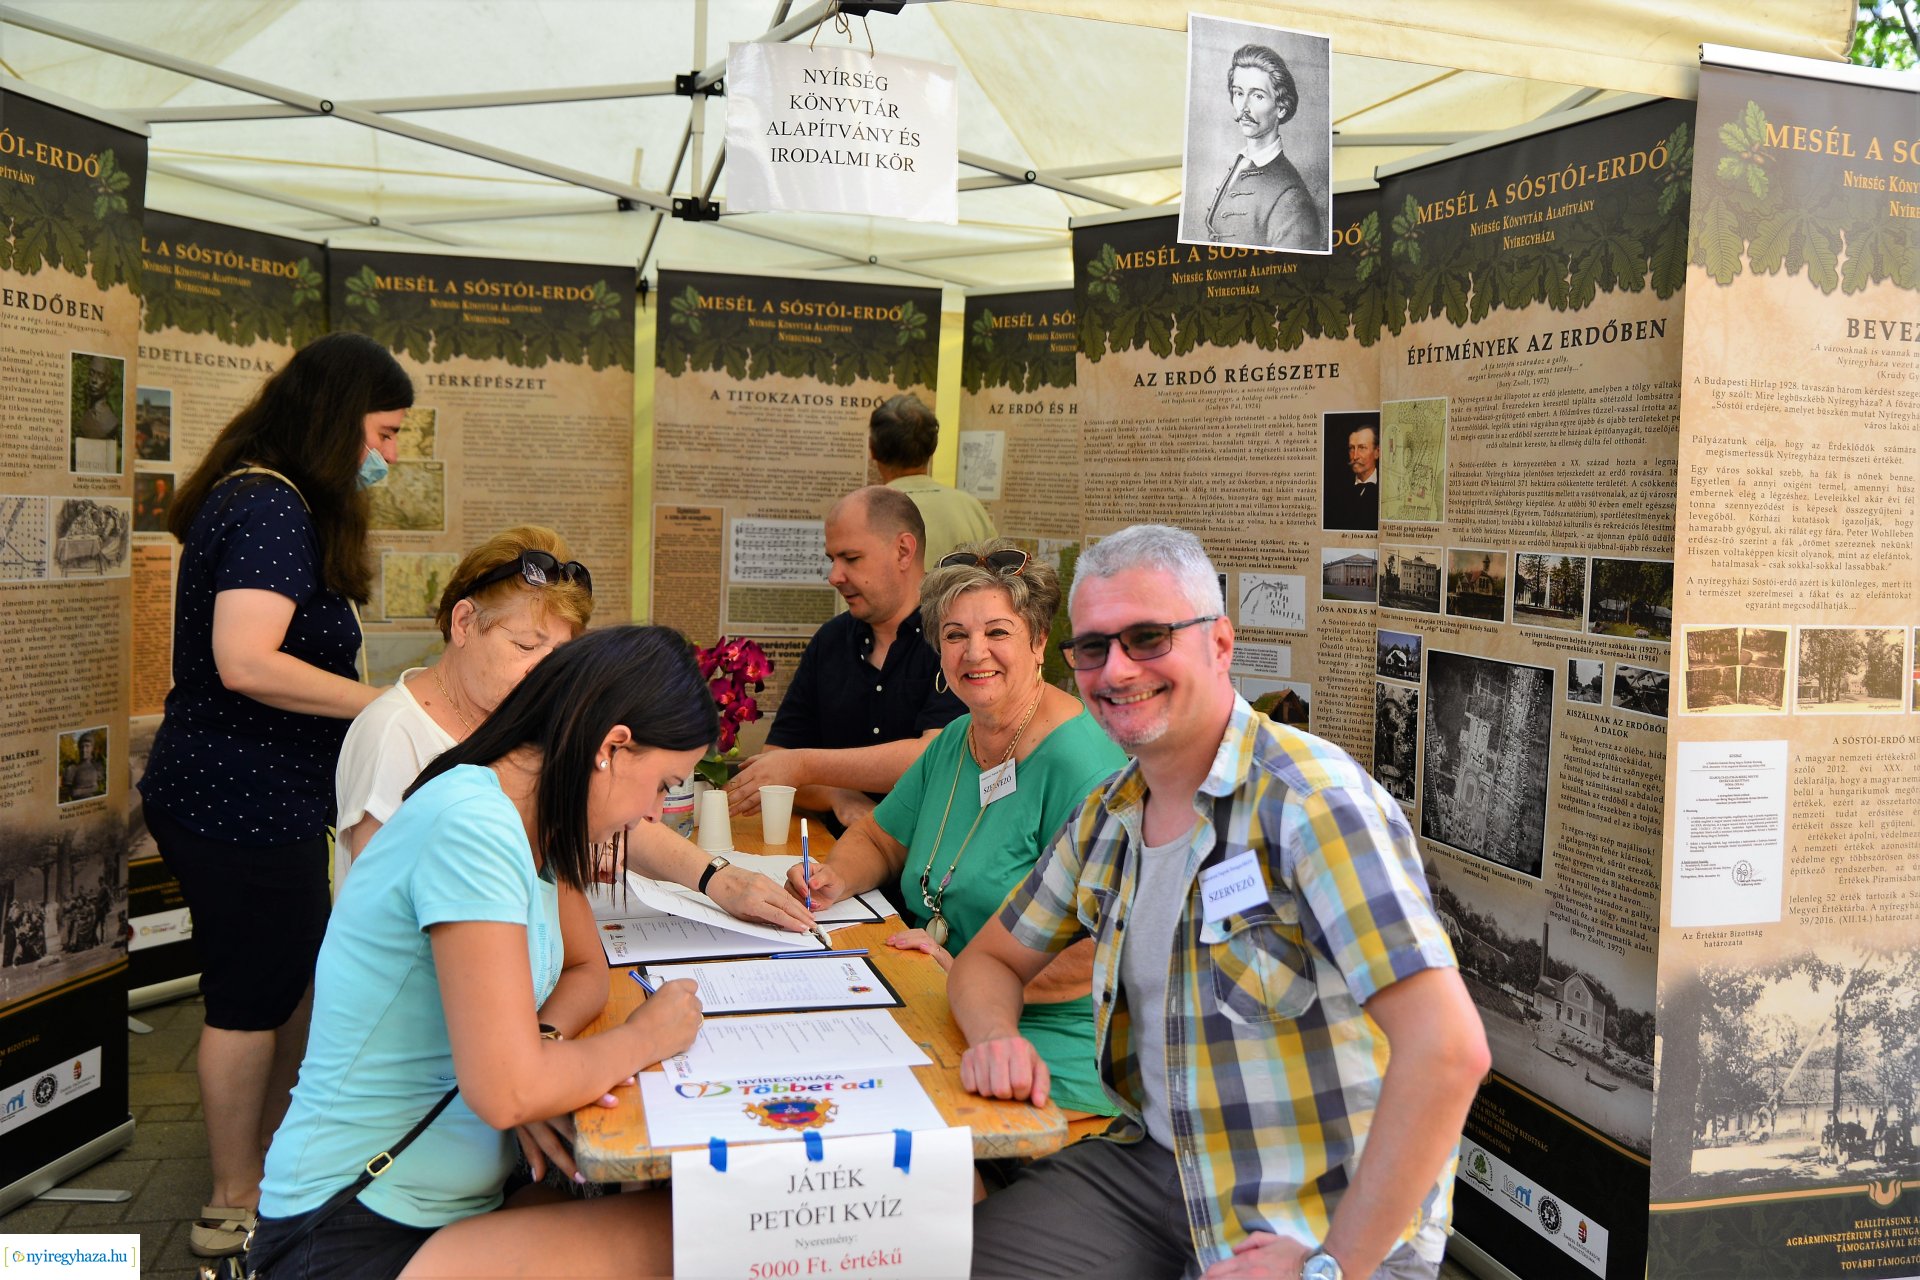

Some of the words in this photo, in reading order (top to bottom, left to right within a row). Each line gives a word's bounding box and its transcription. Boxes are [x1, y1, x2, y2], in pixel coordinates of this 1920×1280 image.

[803, 67, 888, 91] NYÍRSÉG
[790, 93, 900, 119] KÖNYVTÁR
[766, 119, 894, 144] ALAPÍTVÁNY
[899, 127, 920, 147] ÉS
[1764, 123, 1855, 157] MESÉL
[1865, 138, 1884, 161] A
[770, 147, 869, 167] IRODALMI
[876, 153, 915, 172] KÖR
[1417, 191, 1478, 225] MESÉL
[1485, 188, 1498, 209] A
[1505, 140, 1669, 204] SÓSTÓI-ERDŐ
[1844, 171, 1885, 191] NYÍRSÉG
[1470, 219, 1500, 237] NYÍRSÉG
[1503, 210, 1543, 230] KÖNYVTÁR
[1546, 200, 1595, 220] ALAPÍTVÁNY
[1503, 231, 1555, 251] NYÍREGYHÁZA
[157, 241, 170, 256] A
[176, 243, 299, 279] SÓSTÓI-ERDŐ
[1116, 245, 1181, 270] MESÉL
[1187, 246, 1200, 263] A
[374, 275, 438, 293] MESÉL
[445, 281, 458, 294] A
[464, 279, 595, 301] SÓSTÓI-ERDŐ
[2, 288, 104, 322] ERDŐBEN
[698, 296, 756, 312] MESÉL
[763, 301, 775, 313] A
[780, 299, 901, 321] SÓSTÓI-ERDŐ
[992, 312, 1034, 328] MESÉL
[1039, 313, 1048, 326] A
[1407, 336, 1519, 365] ÉPÍTMÉNYEK
[1527, 332, 1553, 352] AZ
[1560, 318, 1667, 347] ERDŐBEN
[426, 374, 547, 390] TÉRKÉPÉSZET
[1134, 373, 1157, 387] AZ
[1166, 366, 1216, 385] ERDŐ
[1225, 363, 1340, 383] RÉGÉSZETE
[1705, 377, 1747, 387] Budapesti
[1750, 379, 1776, 390] Hírlap
[1780, 381, 1799, 390] 1928.
[1801, 384, 1834, 392] tavaszán
[1837, 385, 1862, 394] három
[1865, 387, 1895, 396] kérdést
[710, 390, 720, 400] A
[727, 390, 833, 406] TITOKZATOS
[840, 395, 884, 409] ERDŐ
[989, 404, 1004, 414] AZ
[1009, 400, 1043, 414] ERDŐ
[1050, 401, 1064, 414] ÉS
[1692, 435, 1747, 446] Pályázatunk
[1756, 439, 1776, 448] célja,
[1786, 440, 1804, 450] hogy
[1829, 442, 1875, 452] Érdeklődők
[1706, 448, 1774, 458] megismertessük
[1777, 450, 1826, 462] Nyíregyháza
[1829, 454, 1872, 463] természeti
[1873, 456, 1904, 464] értékét.
[1691, 465, 1708, 475] Egy
[1780, 469, 1803, 477] szebb,
[1890, 473, 1915, 481] benne.
[1697, 578, 1750, 587] nyíregyházi
[1752, 578, 1797, 586] Sóstói-erdő
[1831, 579, 1878, 589] különleges,
[1317, 605, 1334, 613] JÓSA
[1337, 607, 1363, 615] ANDRÁS
[1567, 708, 1610, 724] KISZÁLLNAK
[1613, 718, 1623, 726] AZ
[1626, 720, 1667, 734] ERDŐBŐL
[1602, 726, 1628, 738] DALOK
[1842, 735, 1905, 744] SÓSTÓI-ERDŐ
[1209, 874, 1255, 902] SZERVEZŐ
[1682, 932, 1693, 940] Az
[1696, 928, 1727, 940] Értéktár
[1730, 929, 1763, 940] Bizottság
[1704, 939, 1743, 948] határozata
[736, 1074, 845, 1085] NYÍREGYHÁZA
[739, 1082, 834, 1095] Többet
[841, 1079, 884, 1090] ad!
[787, 1165, 864, 1194] JÁTÉK
[750, 1202, 835, 1231] PETŐFI
[844, 1195, 903, 1221] KVÍZ
[1855, 1216, 1911, 1229] KIÁLLÍTÁSUNK
[795, 1234, 858, 1248] Nyeremény:
[1787, 1230, 1871, 1247] AGRÁRMINISZTÉRIUM
[1874, 1230, 1882, 1239] ÉS
[1885, 1230, 1889, 1238] A
[1837, 1238, 1905, 1253] TÁMOGATÁSÁVAL
[750, 1260, 799, 1279] 5000
[807, 1257, 832, 1274] Ft.
[841, 1249, 903, 1270] értékű
[1841, 1259, 1875, 1270] TOVÁBBI
